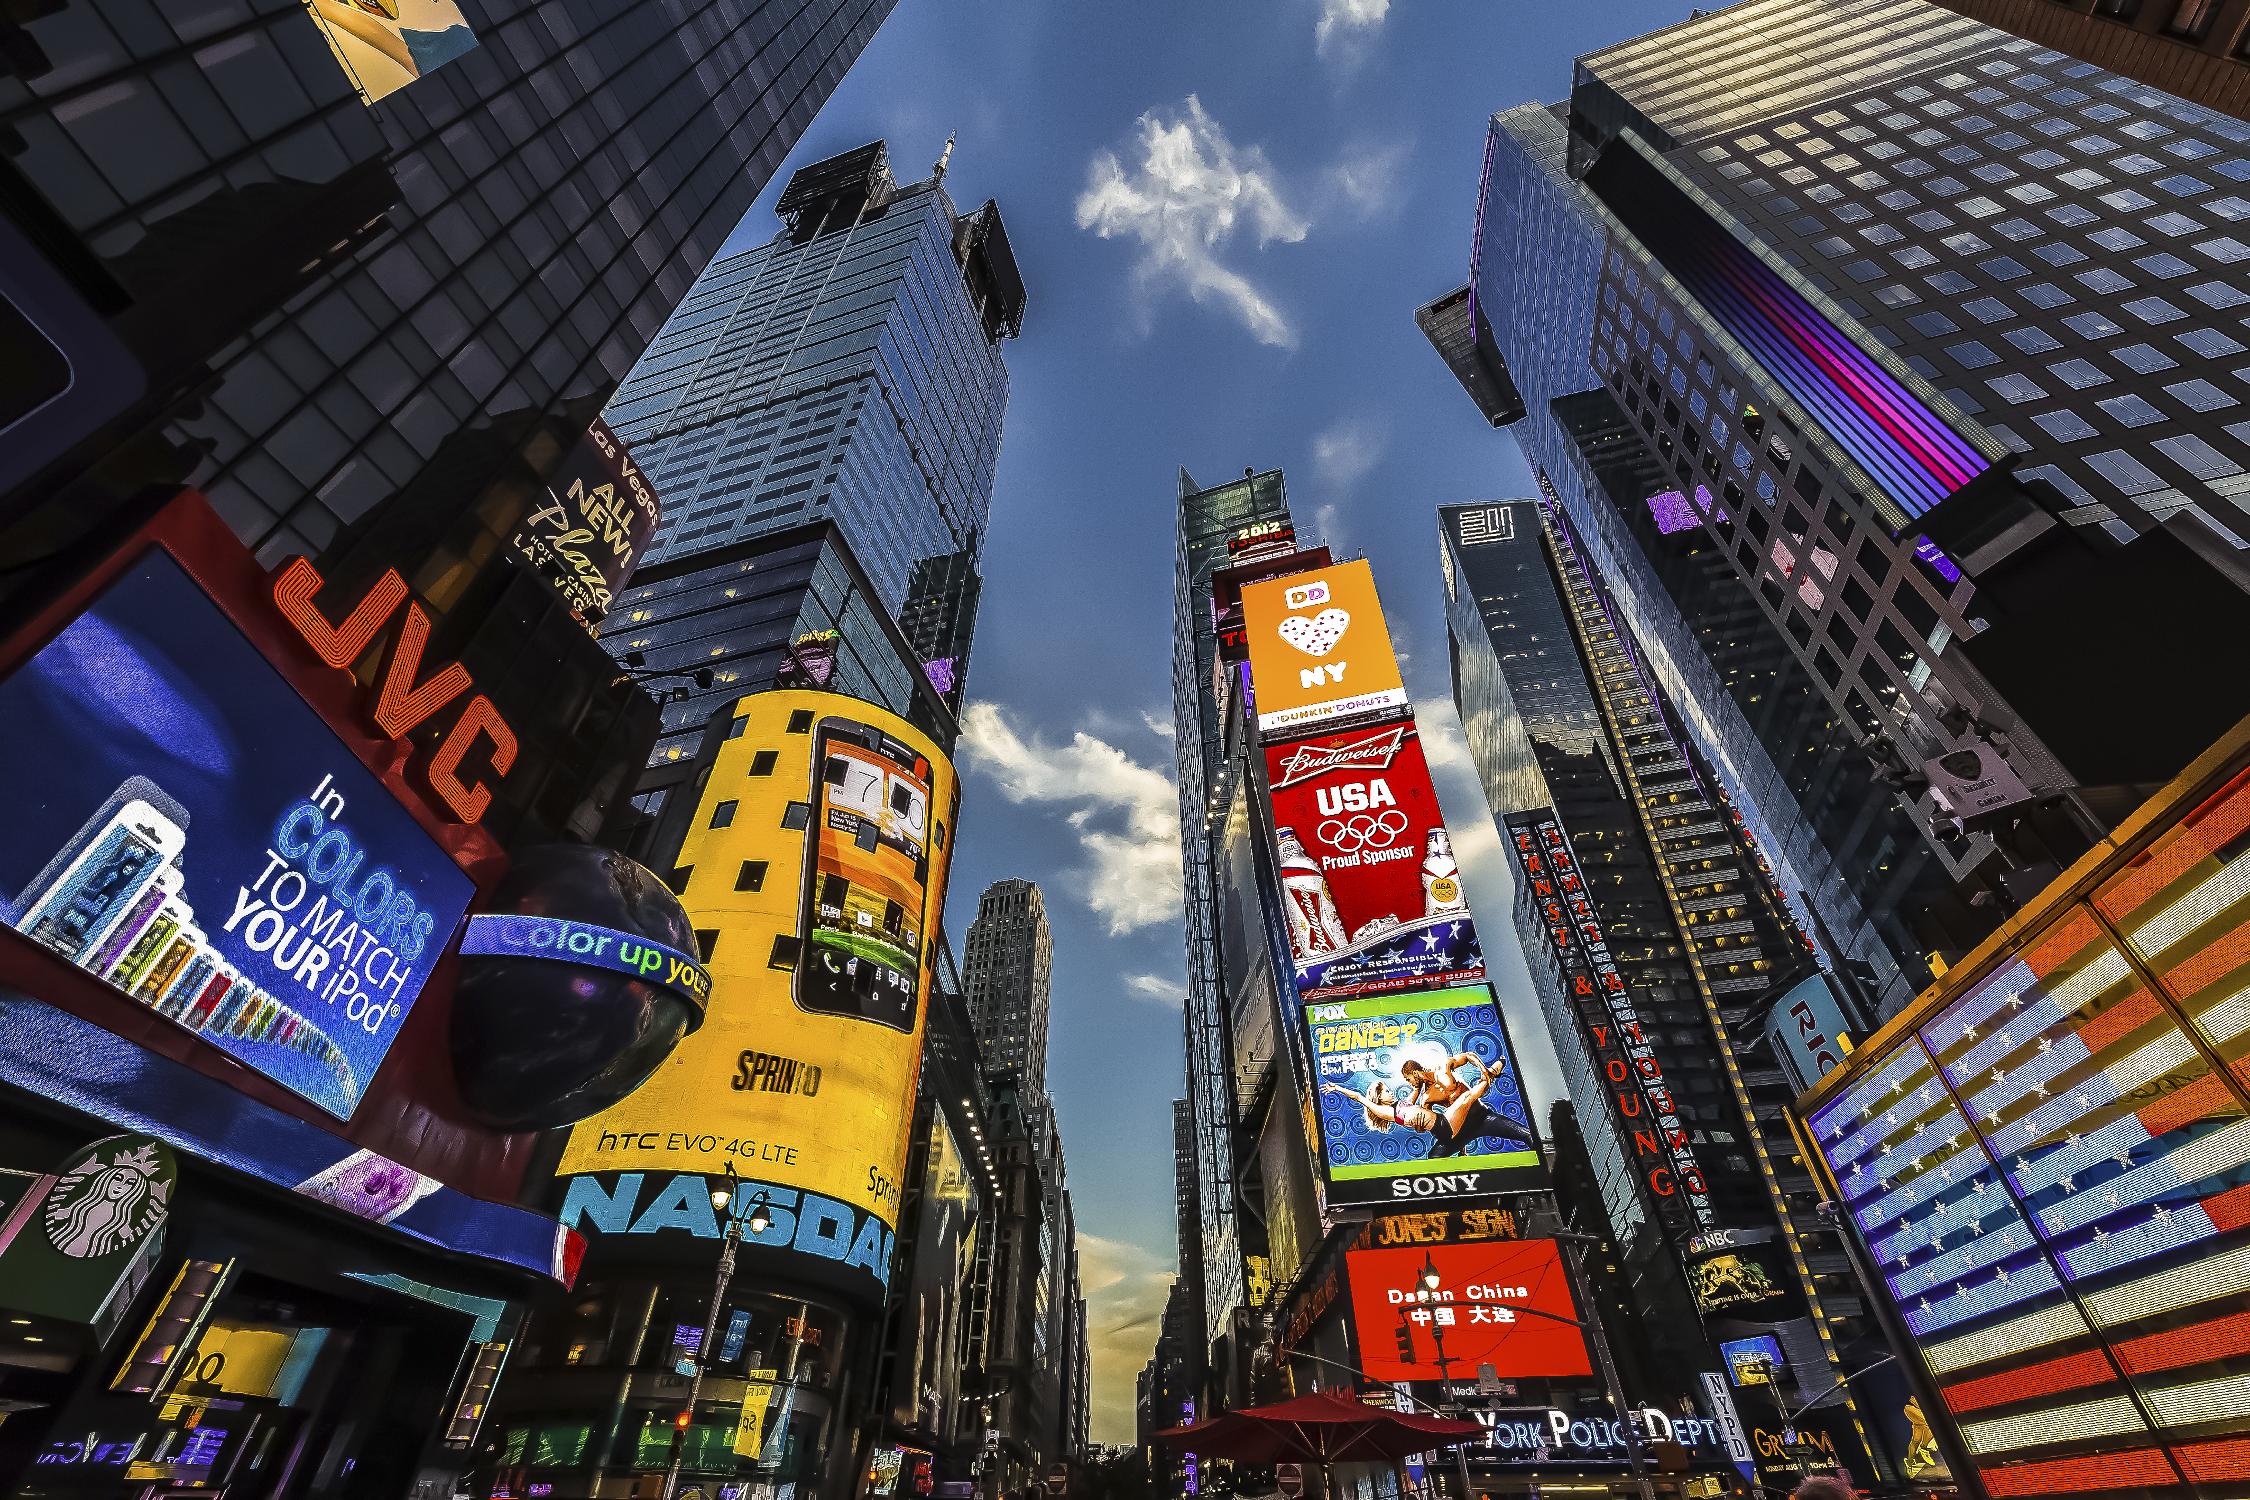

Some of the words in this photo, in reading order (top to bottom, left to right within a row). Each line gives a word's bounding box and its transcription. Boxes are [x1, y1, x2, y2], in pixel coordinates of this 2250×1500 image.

[588, 418, 616, 459] Las
[622, 456, 658, 526] Vegas
[567, 478, 633, 569] NEW!
[593, 483, 635, 535] ALL
[530, 534, 555, 560] HOTE
[1239, 521, 1281, 541] 2012
[527, 486, 613, 615] Plaza
[1291, 588, 1325, 604] DD
[274, 556, 518, 824] JVC
[1300, 661, 1347, 689] NY
[1336, 695, 1391, 712] DONUTS
[1280, 741, 1402, 773] Budweiser
[310, 773, 345, 821] In
[833, 788, 844, 796] PM
[858, 770, 879, 803] 7
[1316, 778, 1397, 817] USA
[1322, 853, 1361, 871] Proud
[1364, 845, 1416, 866] Sponsor
[278, 804, 434, 961] COLORS
[223, 885, 331, 992] YOUR
[252, 848, 307, 912] TO
[300, 894, 412, 1000] MATCH
[619, 941, 662, 975] up
[1330, 963, 1362, 973] ENJOY
[1368, 980, 1405, 991] GRAB
[1446, 969, 1482, 981] BUDS
[1314, 1003, 1350, 1022] FOX
[1519, 833, 1567, 947] ERNST
[1575, 975, 1593, 995] &
[1593, 1027, 1675, 1196] YOUNG
[725, 1137, 756, 1158] 4G
[762, 1144, 799, 1166] LTE
[1391, 1174, 1480, 1197] SONY
[1704, 1230, 1735, 1249] NBC
[1387, 1288, 1454, 1304] Daan
[1466, 1284, 1528, 1300] China
[1411, 1307, 1456, 1326] 中国
[1468, 1305, 1516, 1324] 大连
[1643, 1408, 1717, 1447] DEPT
[1709, 1375, 1747, 1459] NYPD
